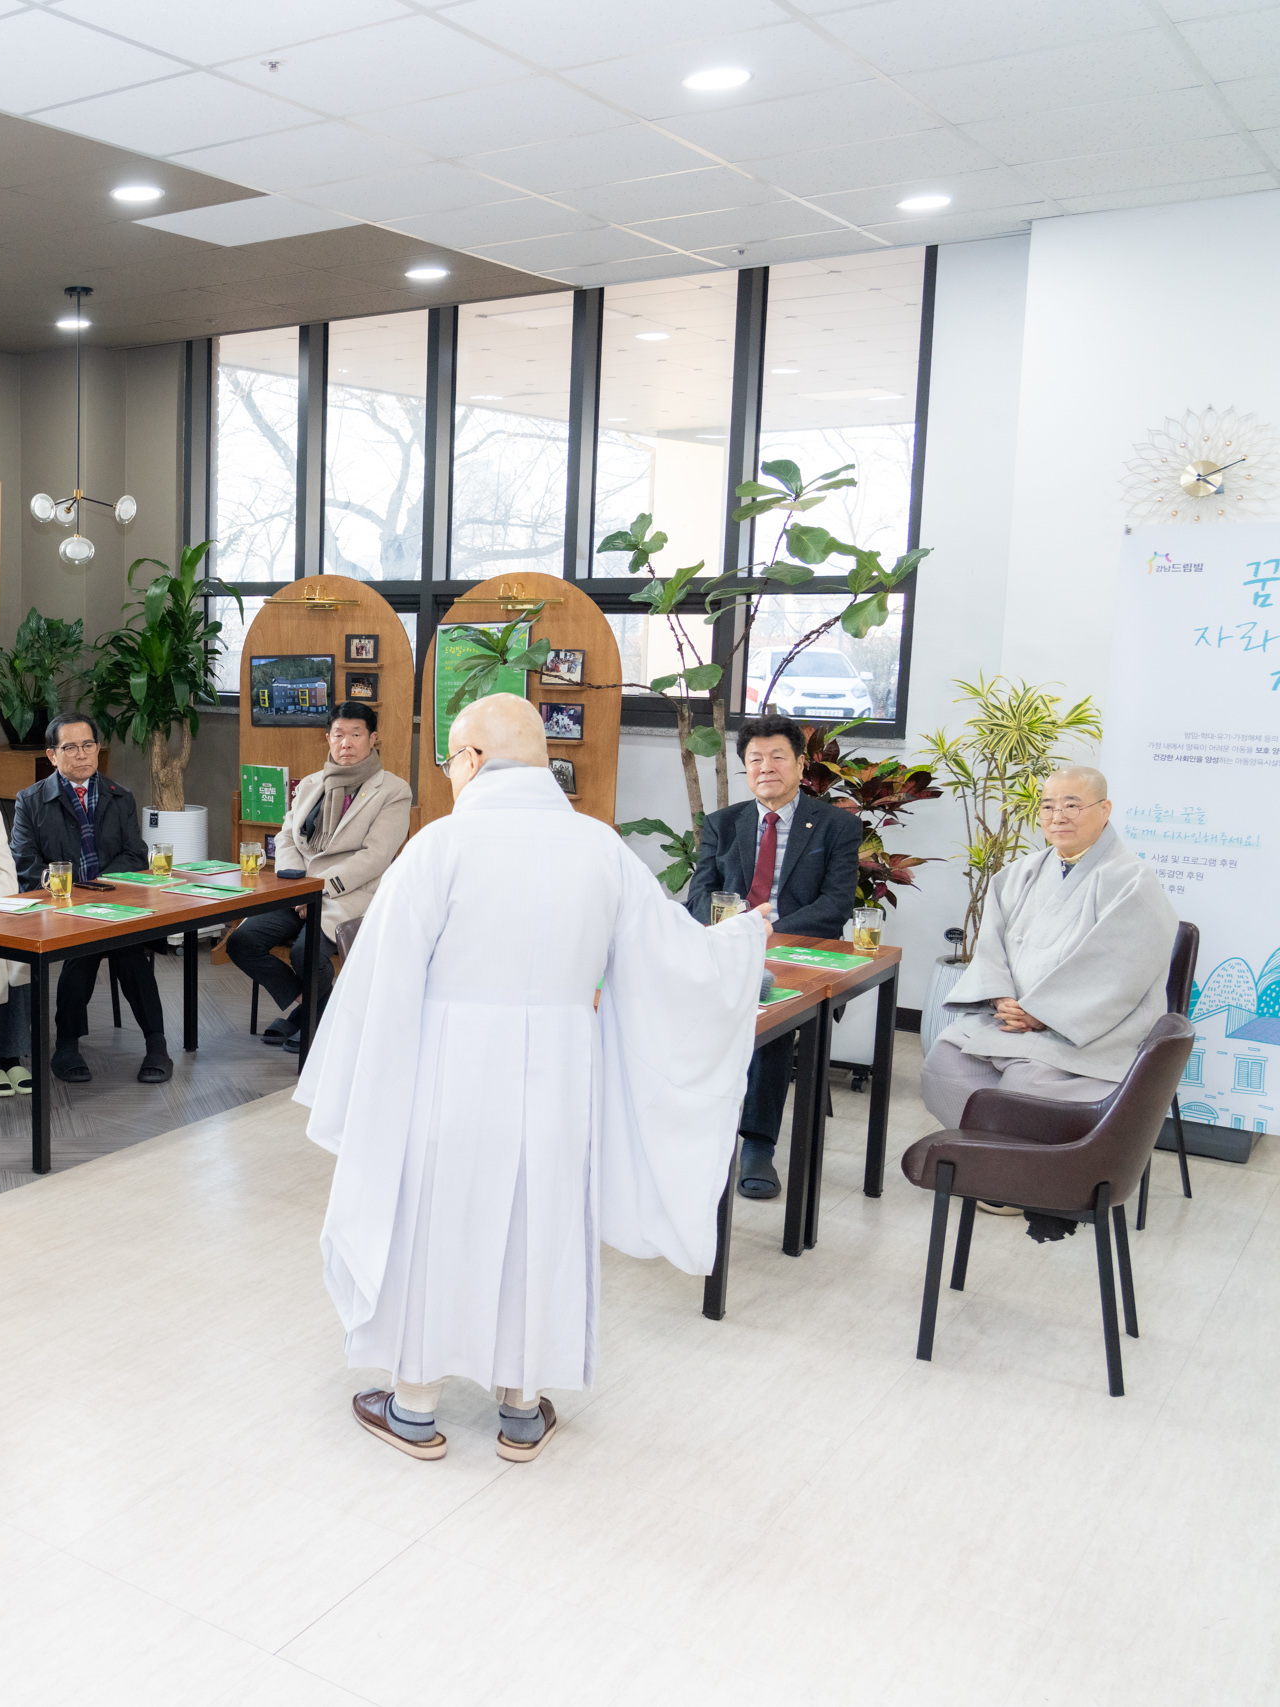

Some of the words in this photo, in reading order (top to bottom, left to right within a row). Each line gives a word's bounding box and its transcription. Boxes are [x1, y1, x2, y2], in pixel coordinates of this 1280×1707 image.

[1156, 563, 1204, 573] 강남드림빌
[1147, 741, 1162, 750] 가정
[1163, 742, 1184, 751] 내에서
[1185, 743, 1207, 752] 양육이
[1208, 744, 1230, 753] 어려운
[1231, 745, 1253, 754] 아동을
[1255, 746, 1270, 754] 보호
[1153, 753, 1174, 762] 건강한
[1175, 755, 1203, 764] 사회인을
[1205, 756, 1234, 765] 양성하는
[1126, 803, 1174, 823] 아이들의
[1181, 806, 1206, 825] 꿈을
[1125, 824, 1156, 839] 함께
[1163, 830, 1261, 847] 디자인해주세요!
[1151, 853, 1169, 864] 시설
[1171, 855, 1180, 864] 및
[1181, 856, 1217, 867] 프로그램
[1219, 858, 1238, 869] 후원
[1186, 871, 1204, 881] 후원
[1168, 884, 1185, 894] 후원
